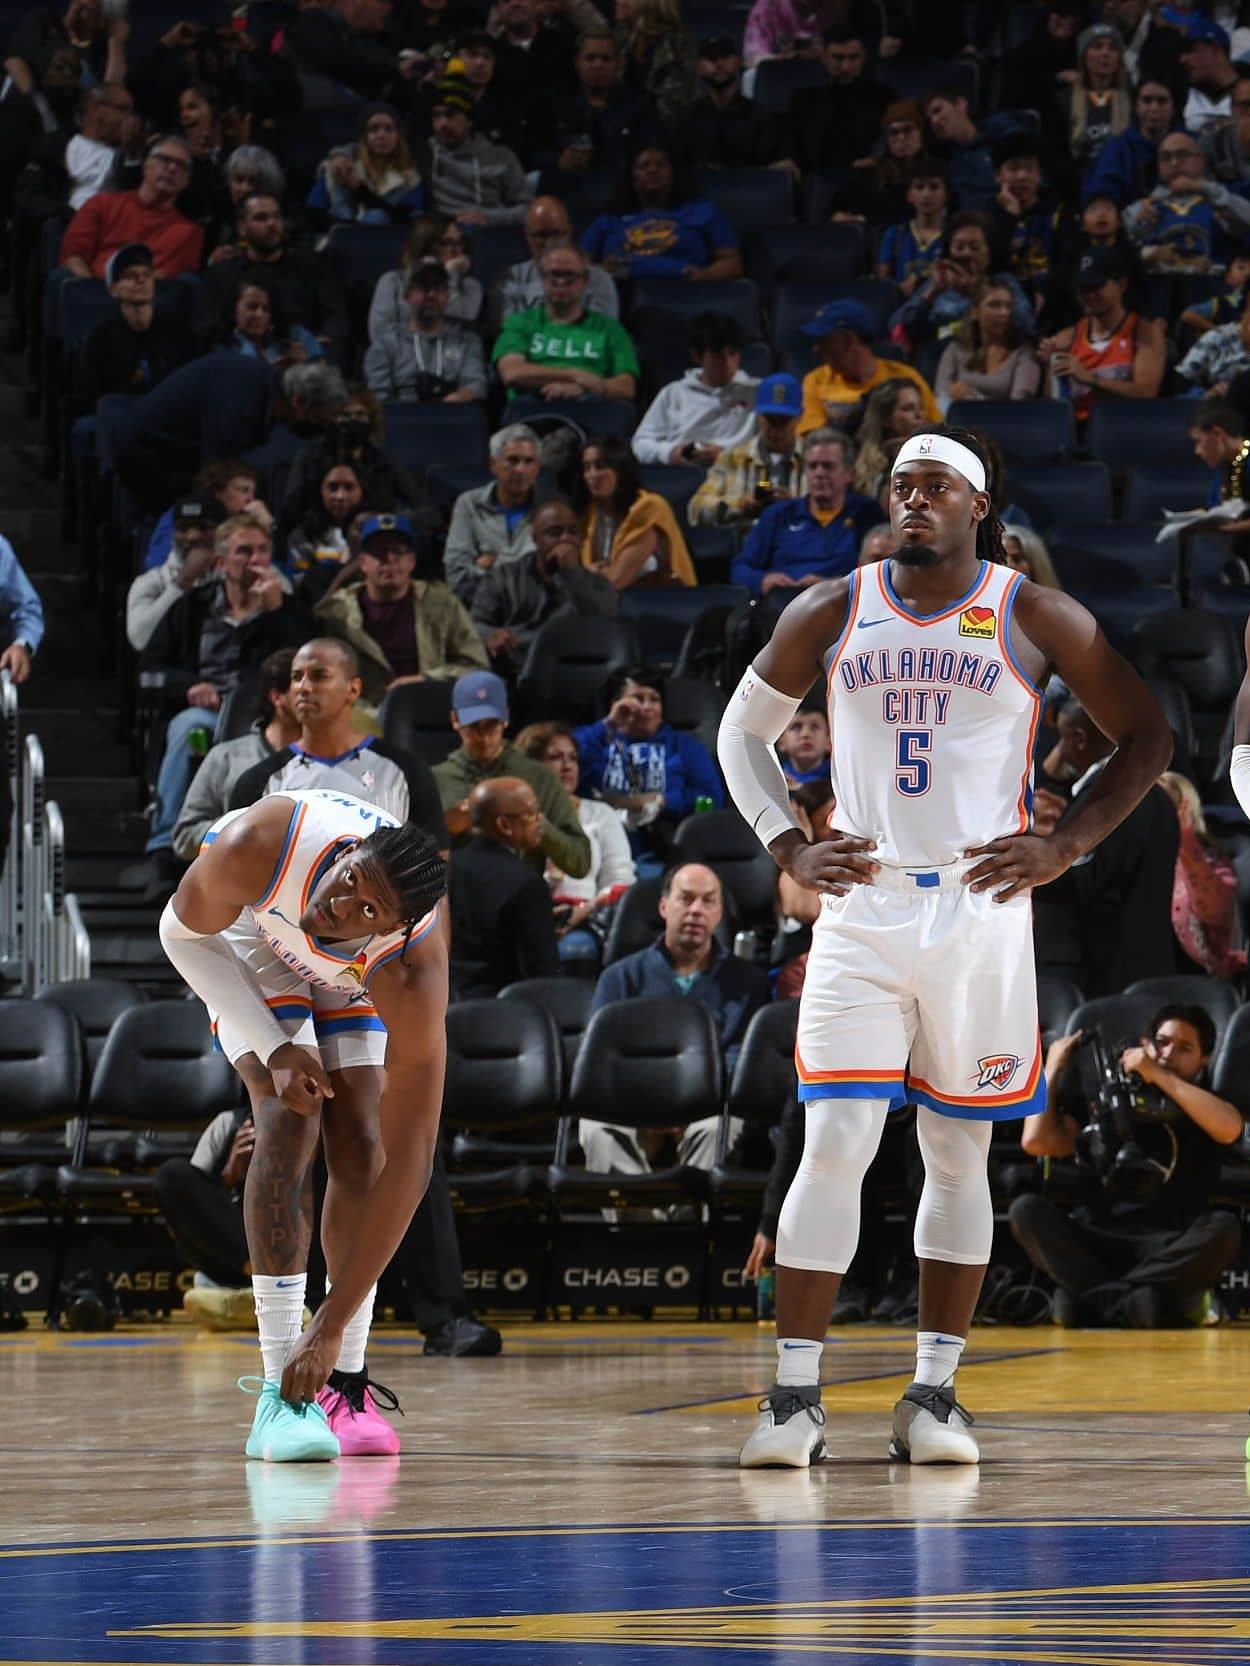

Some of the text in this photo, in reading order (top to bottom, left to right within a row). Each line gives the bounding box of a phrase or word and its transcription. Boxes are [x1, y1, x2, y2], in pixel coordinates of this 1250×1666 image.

[529, 332, 601, 358] SELL
[839, 648, 1003, 696] OKLAHOMA
[883, 689, 951, 725] CITY
[895, 728, 933, 797] 5
[105, 1271, 171, 1291] ASE
[563, 1266, 660, 1288] CHASE
